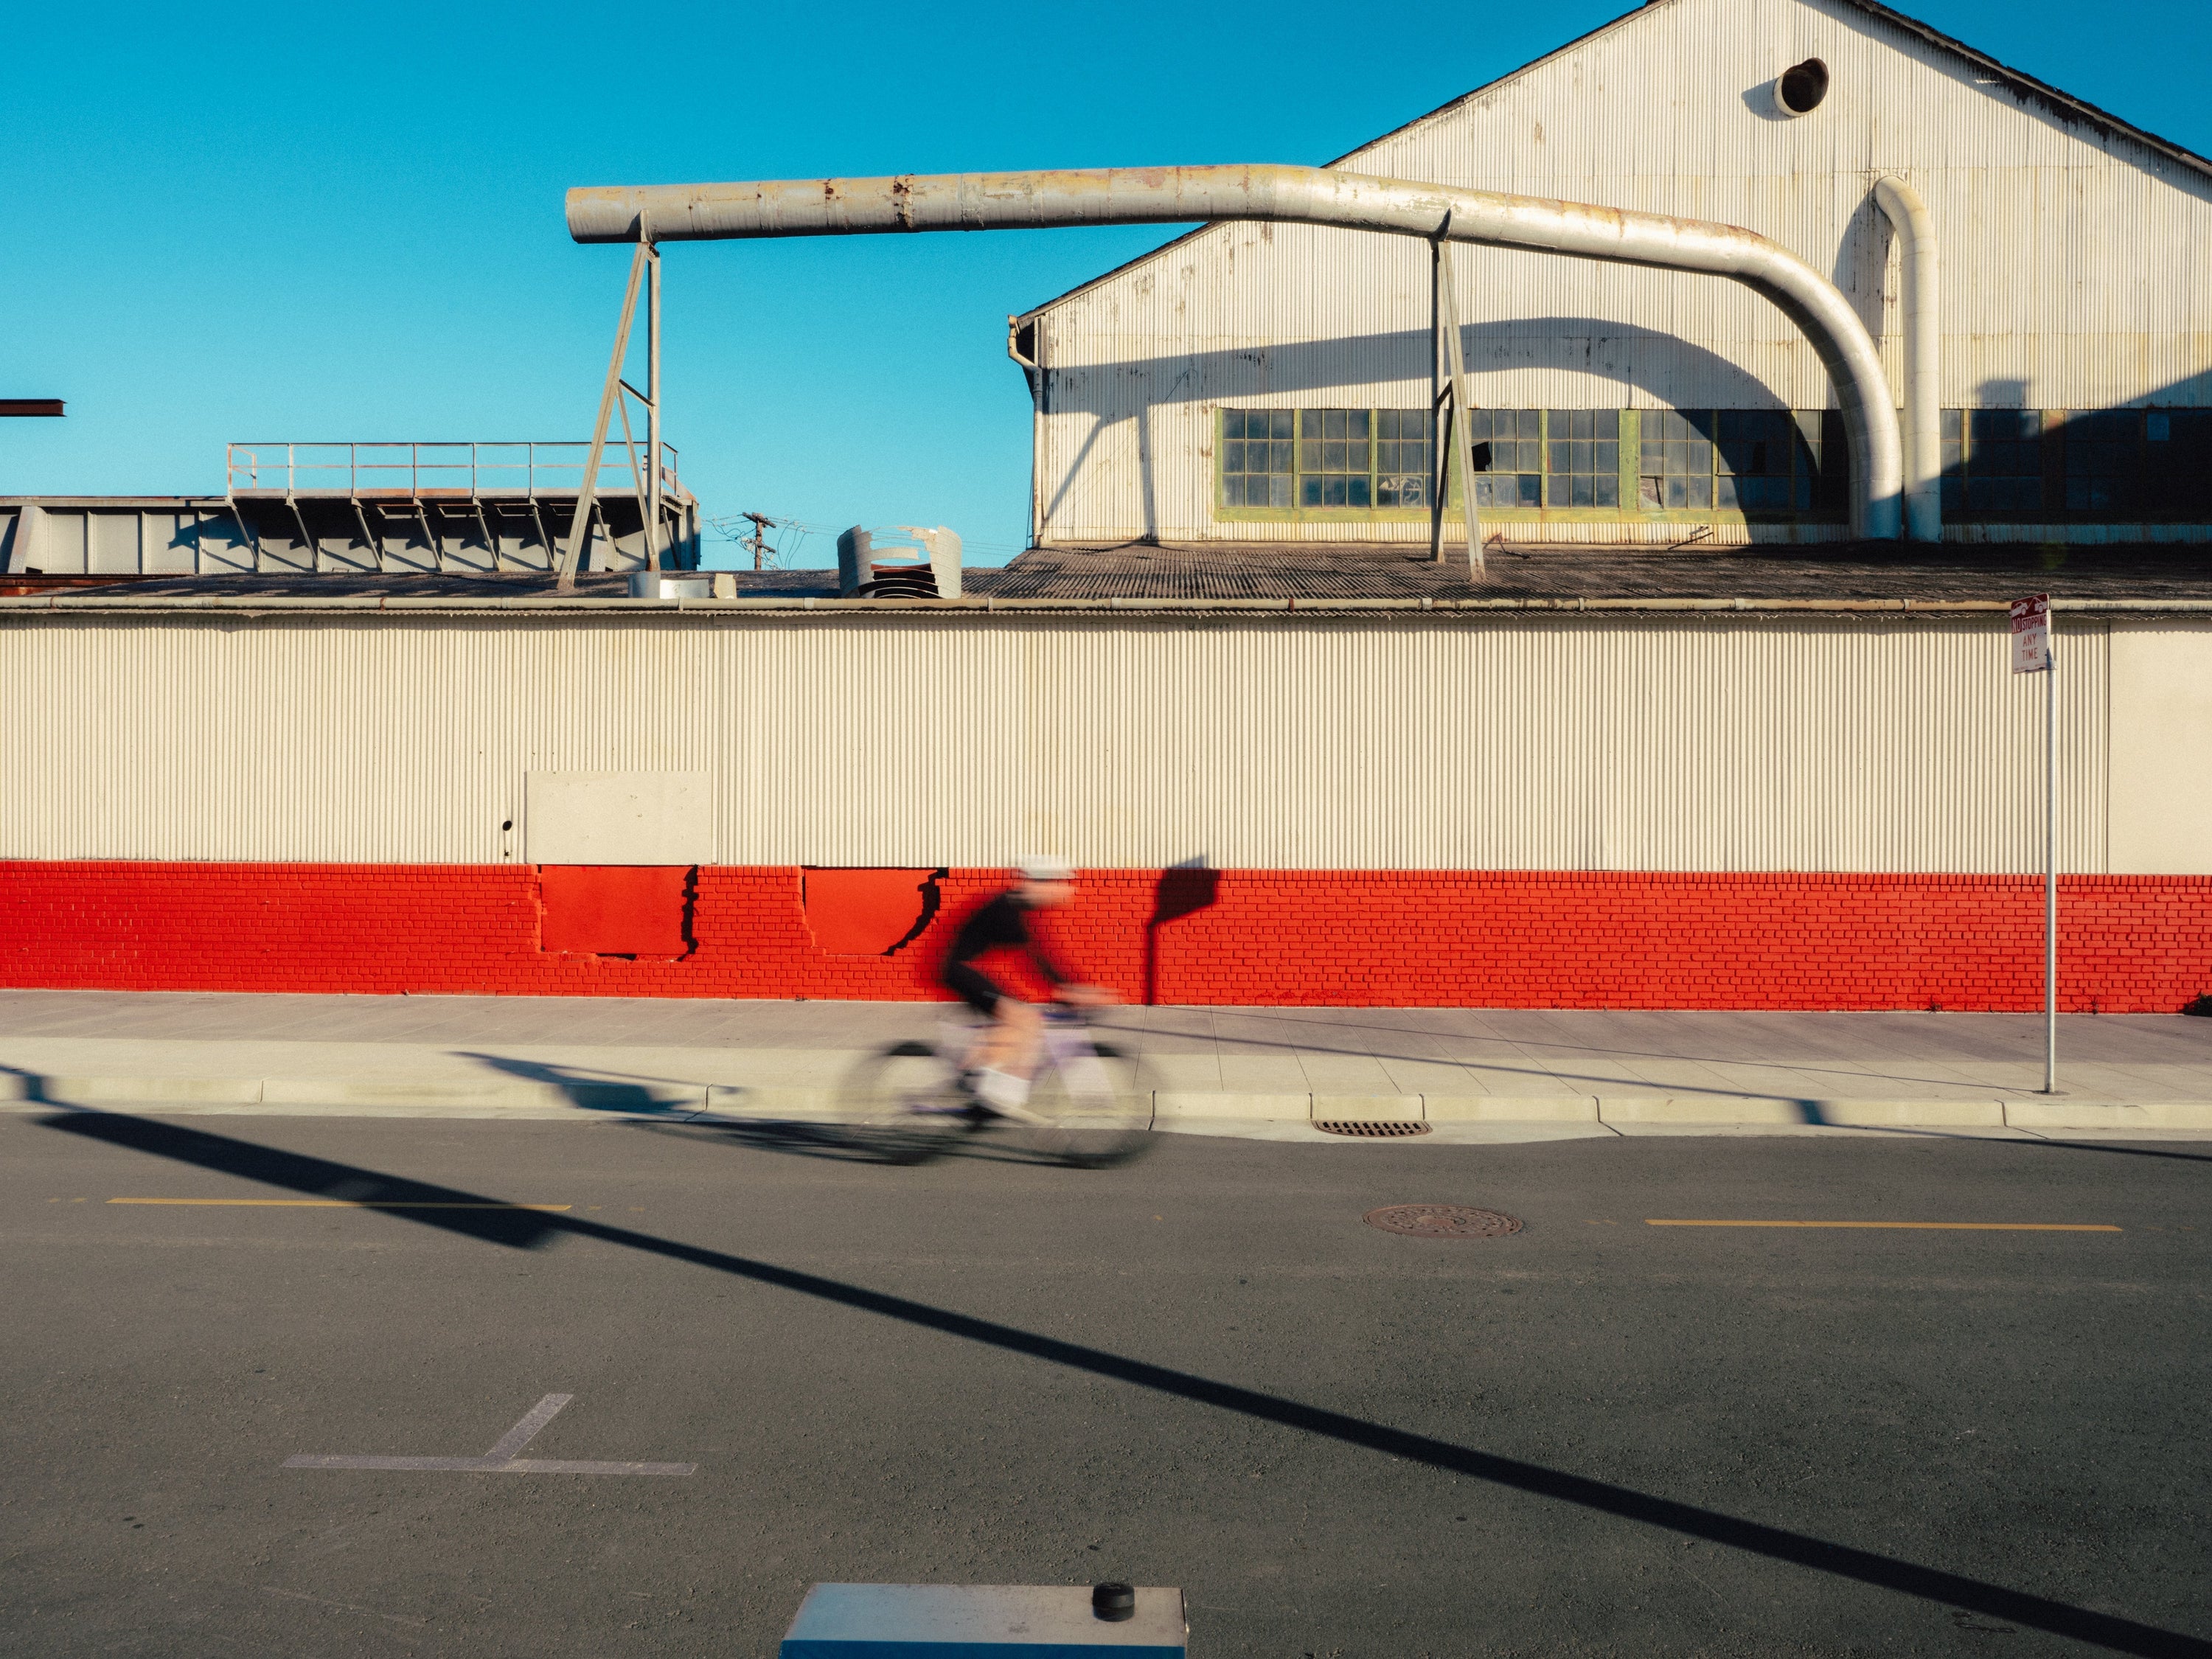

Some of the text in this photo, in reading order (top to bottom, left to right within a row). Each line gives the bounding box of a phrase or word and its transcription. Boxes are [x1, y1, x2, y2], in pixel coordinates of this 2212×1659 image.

[2012, 615, 2046, 633] NO STOPPING
[2023, 633, 2037, 647] ANY
[2022, 648, 2038, 661] TIME
